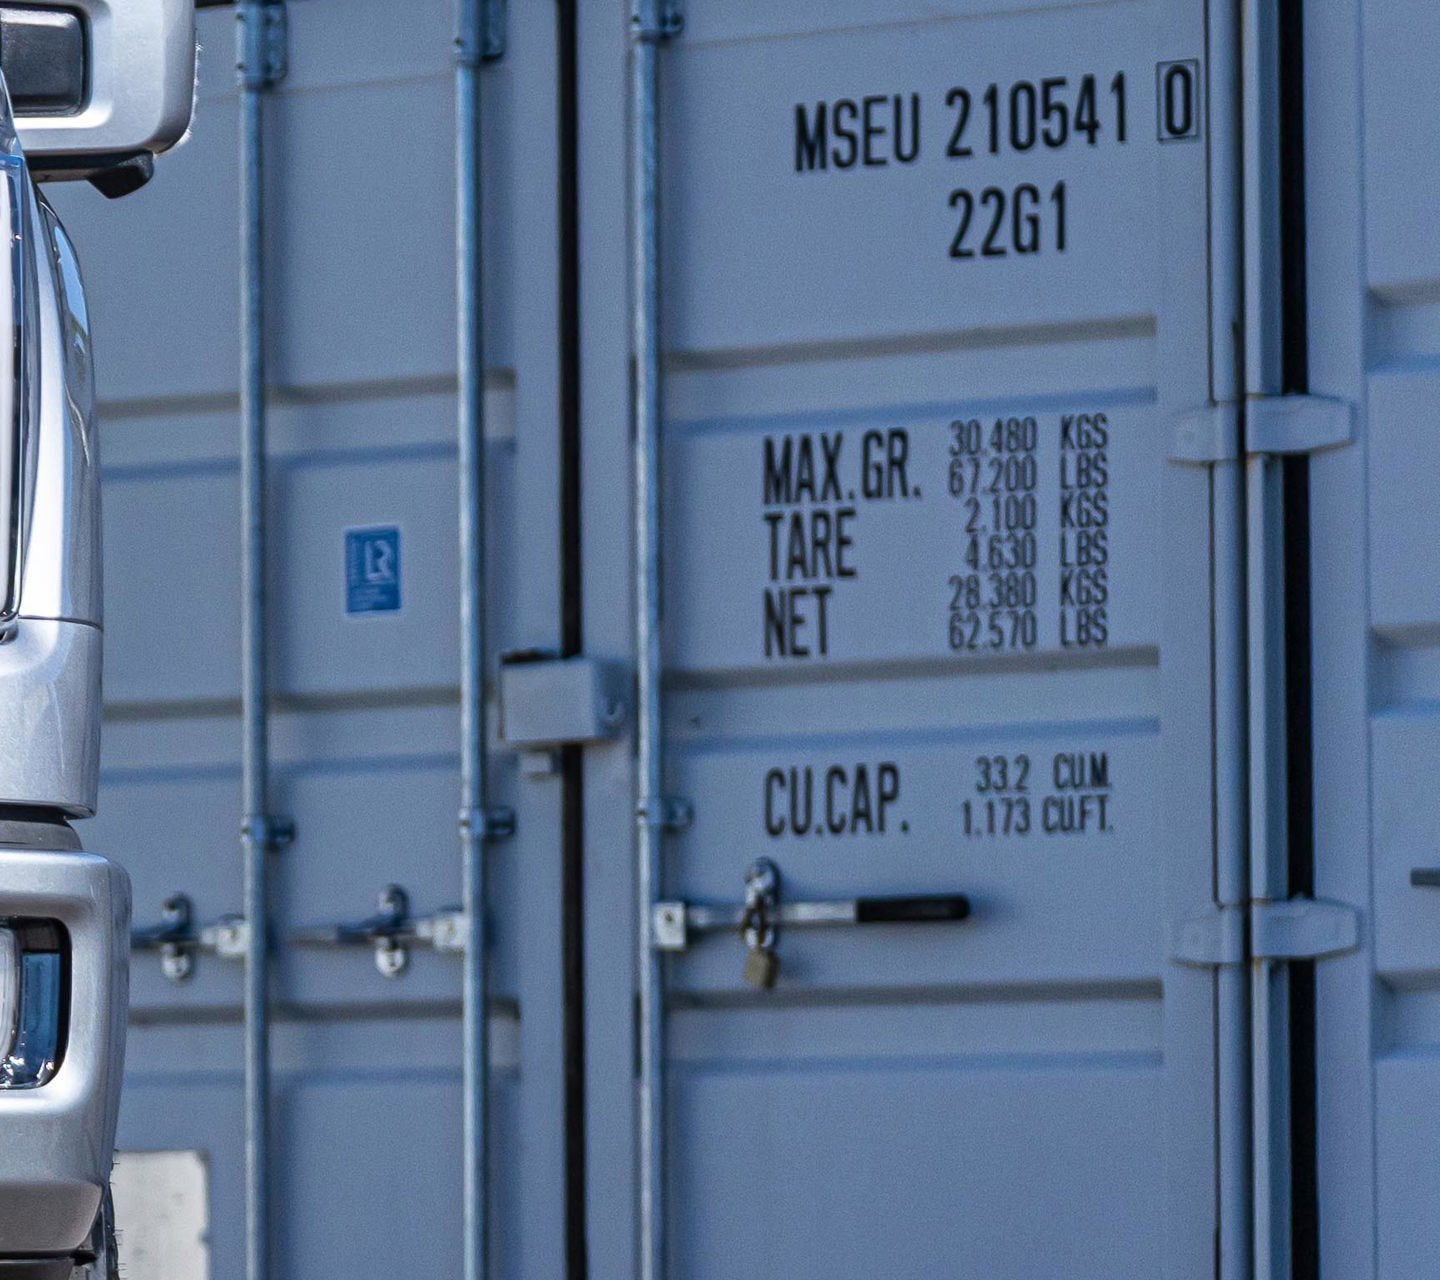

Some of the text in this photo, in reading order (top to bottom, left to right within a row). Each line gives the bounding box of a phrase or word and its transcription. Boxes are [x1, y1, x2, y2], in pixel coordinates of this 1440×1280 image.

[795, 64, 1193, 172] MSEU 210541 0
[948, 179, 1067, 259] 22G1
[949, 417, 1037, 458] 30.480
[1060, 413, 1108, 451] KGS
[948, 452, 1108, 496] 67.200 LBS
[763, 491, 1108, 580] TARE 2.100 KGS
[965, 529, 1108, 572] 4.630 LBS
[763, 568, 1108, 659] NET 28.380 KGS
[948, 607, 1108, 650] 62.570 LBS
[763, 760, 910, 837] CU.CAP.
[961, 796, 1031, 837] 1.173
